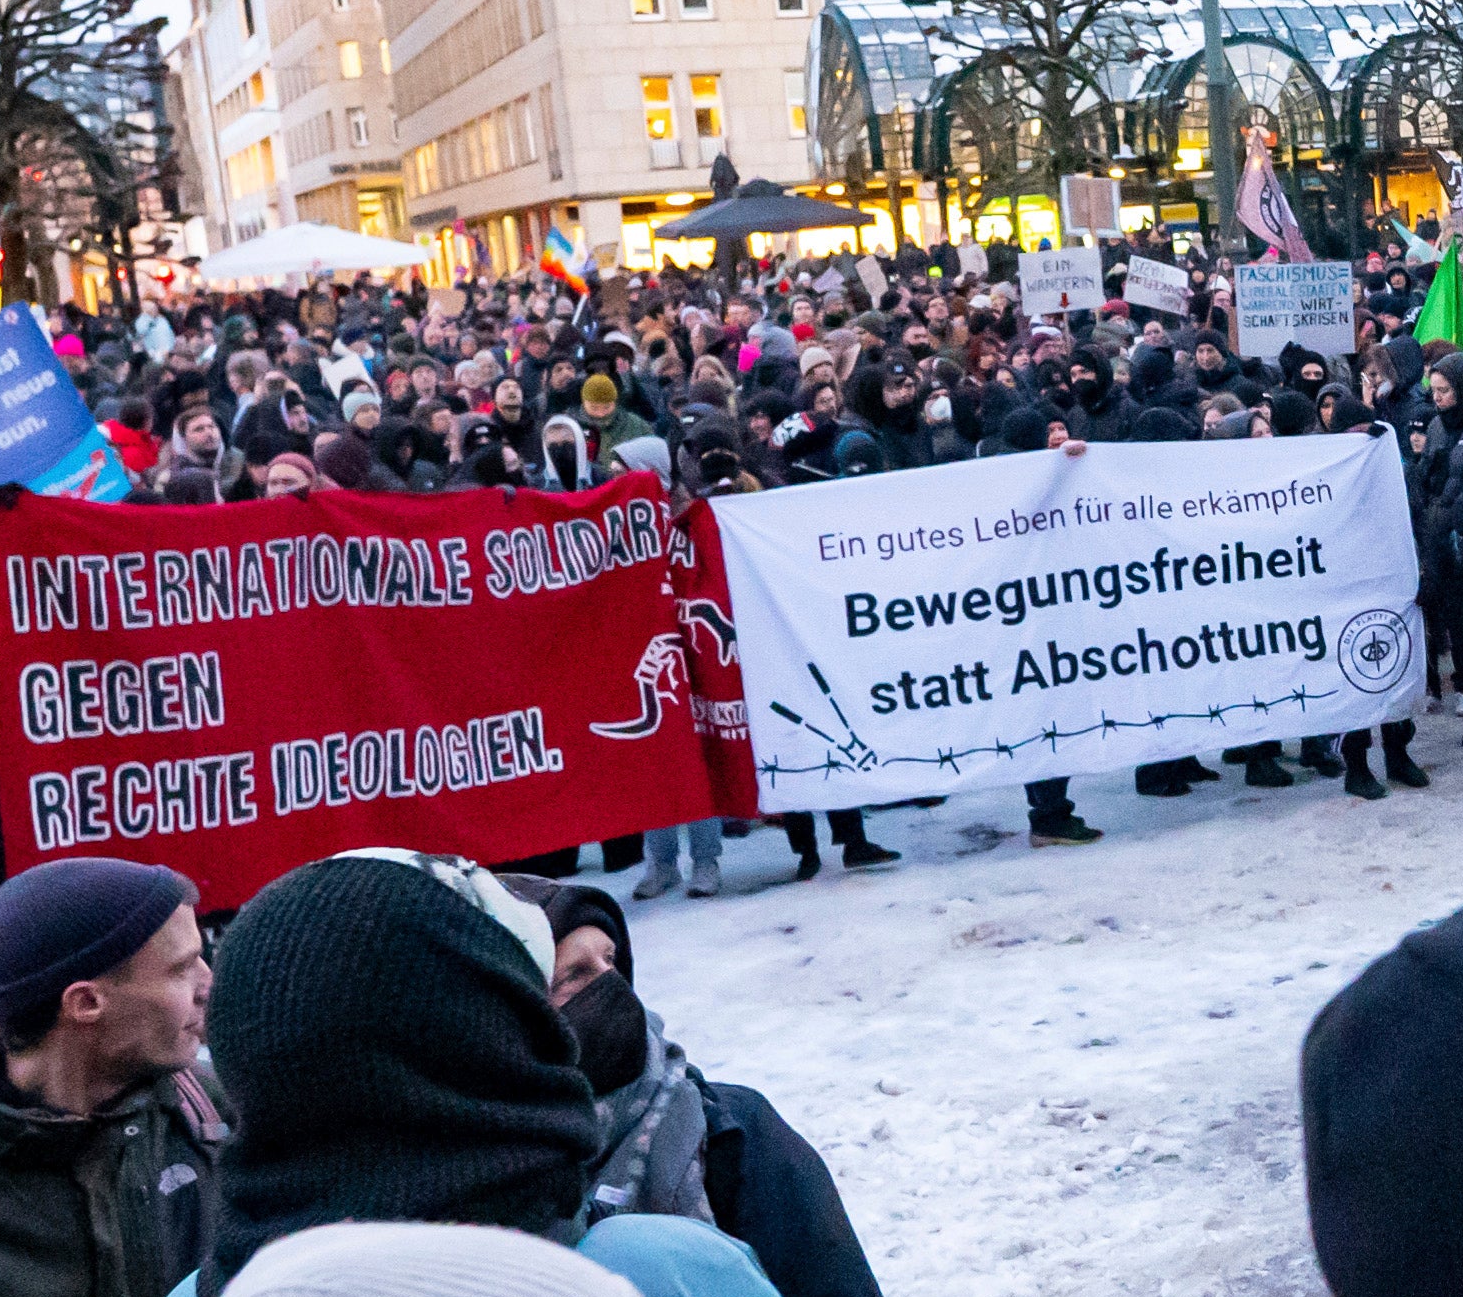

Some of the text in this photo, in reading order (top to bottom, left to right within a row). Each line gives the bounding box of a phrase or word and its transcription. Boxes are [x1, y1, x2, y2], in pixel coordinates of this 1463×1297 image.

[1243, 311, 1349, 328] SCHAFTSKRISEN
[0, 370, 57, 409] neue
[818, 478, 1333, 562] Ein gutes Leben für alle erkämpfen
[6, 533, 473, 634] INTERNATIONALE
[844, 535, 1327, 638] Bewegungsfreiheit
[19, 651, 226, 744] GEGEN
[870, 615, 1327, 715] statt Abschottung
[29, 751, 258, 852] RECHTE
[271, 706, 565, 816] IDEOLOGIEN.
